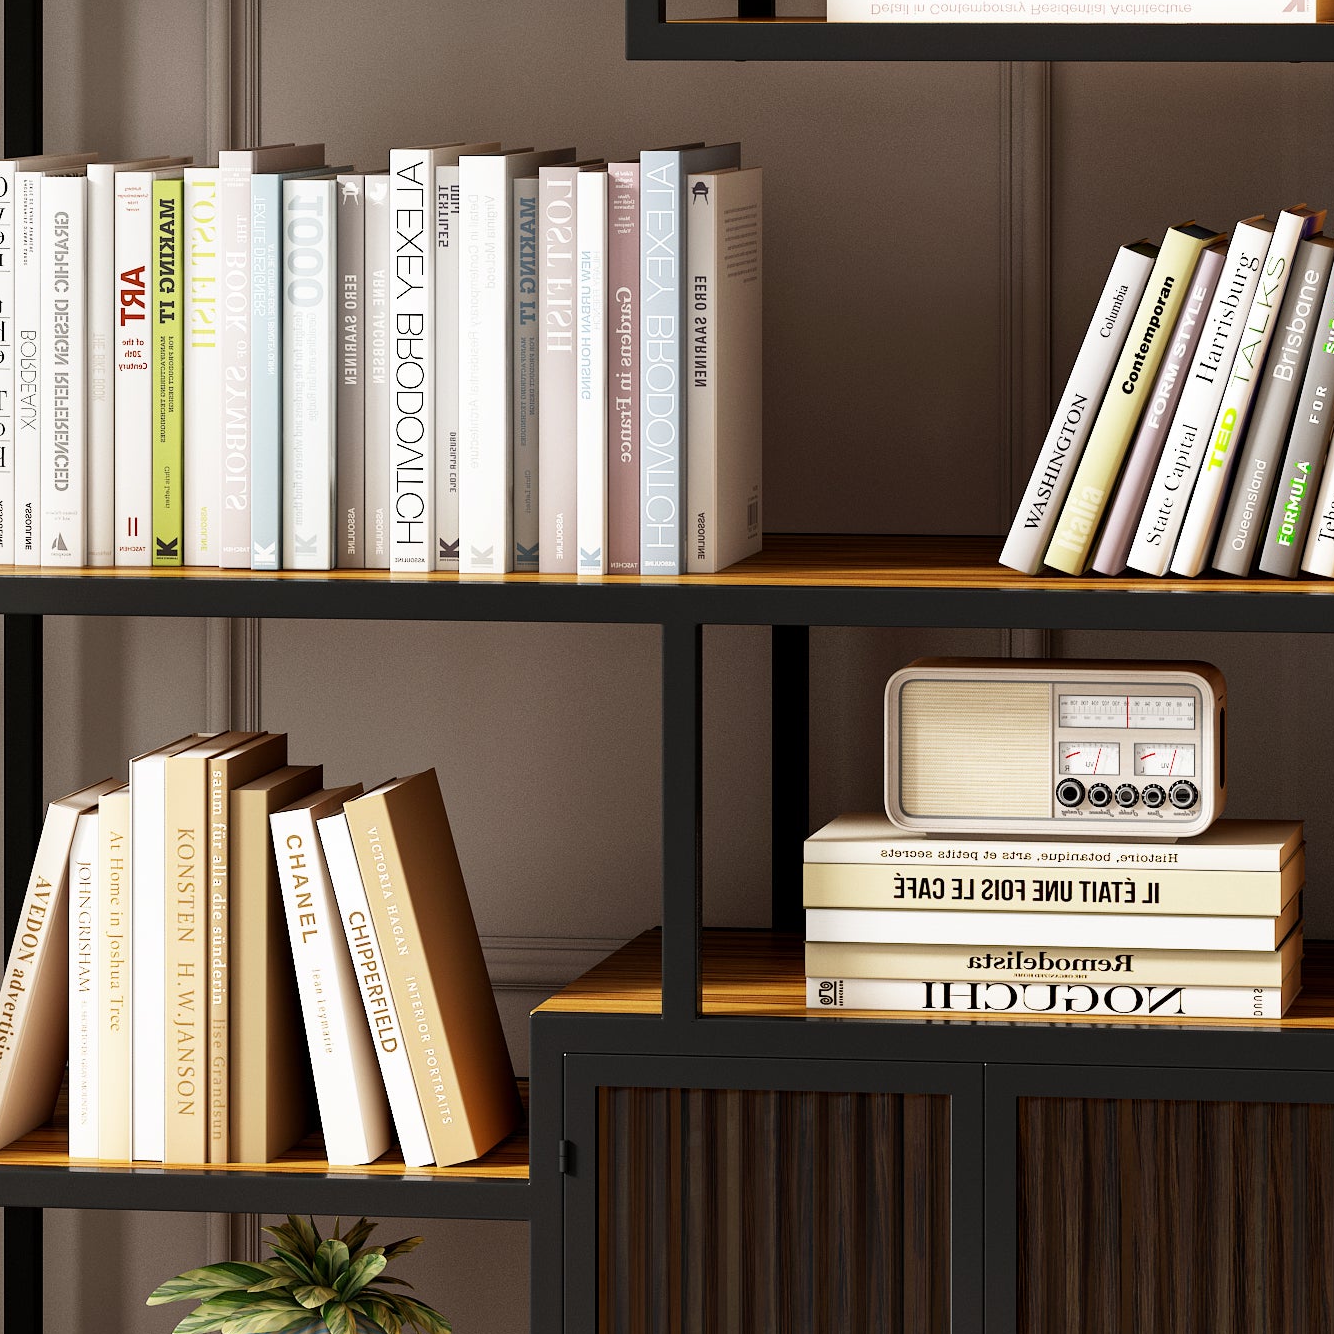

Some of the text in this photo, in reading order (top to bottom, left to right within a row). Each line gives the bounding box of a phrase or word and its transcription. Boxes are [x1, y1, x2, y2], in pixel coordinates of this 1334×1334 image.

[1024, 284, 1129, 530] WASHINGTON Columbia
[1057, 275, 1175, 554] Italia Contemporan
[1145, 252, 1260, 547] State Capital Harrisburg
[1147, 285, 1208, 430] FORM STYLE
[1207, 256, 1286, 471] TED TALKS
[1232, 268, 1320, 551] Queensland Brisbane
[1276, 460, 1312, 547] FORMULA
[1309, 385, 1328, 425] FOR
[17, 874, 53, 965] AVEDON
[106, 831, 124, 1032] At Home in Joshua Tree
[177, 828, 195, 943] KONSTEN
[212, 770, 227, 1006] saum für alla die sünderin
[286, 834, 318, 944] CHANEL
[348, 911, 398, 1054] CHIPPERFIELD
[367, 826, 453, 1126] VICTORIA HAGAN INTERIOR PORTRAITS
